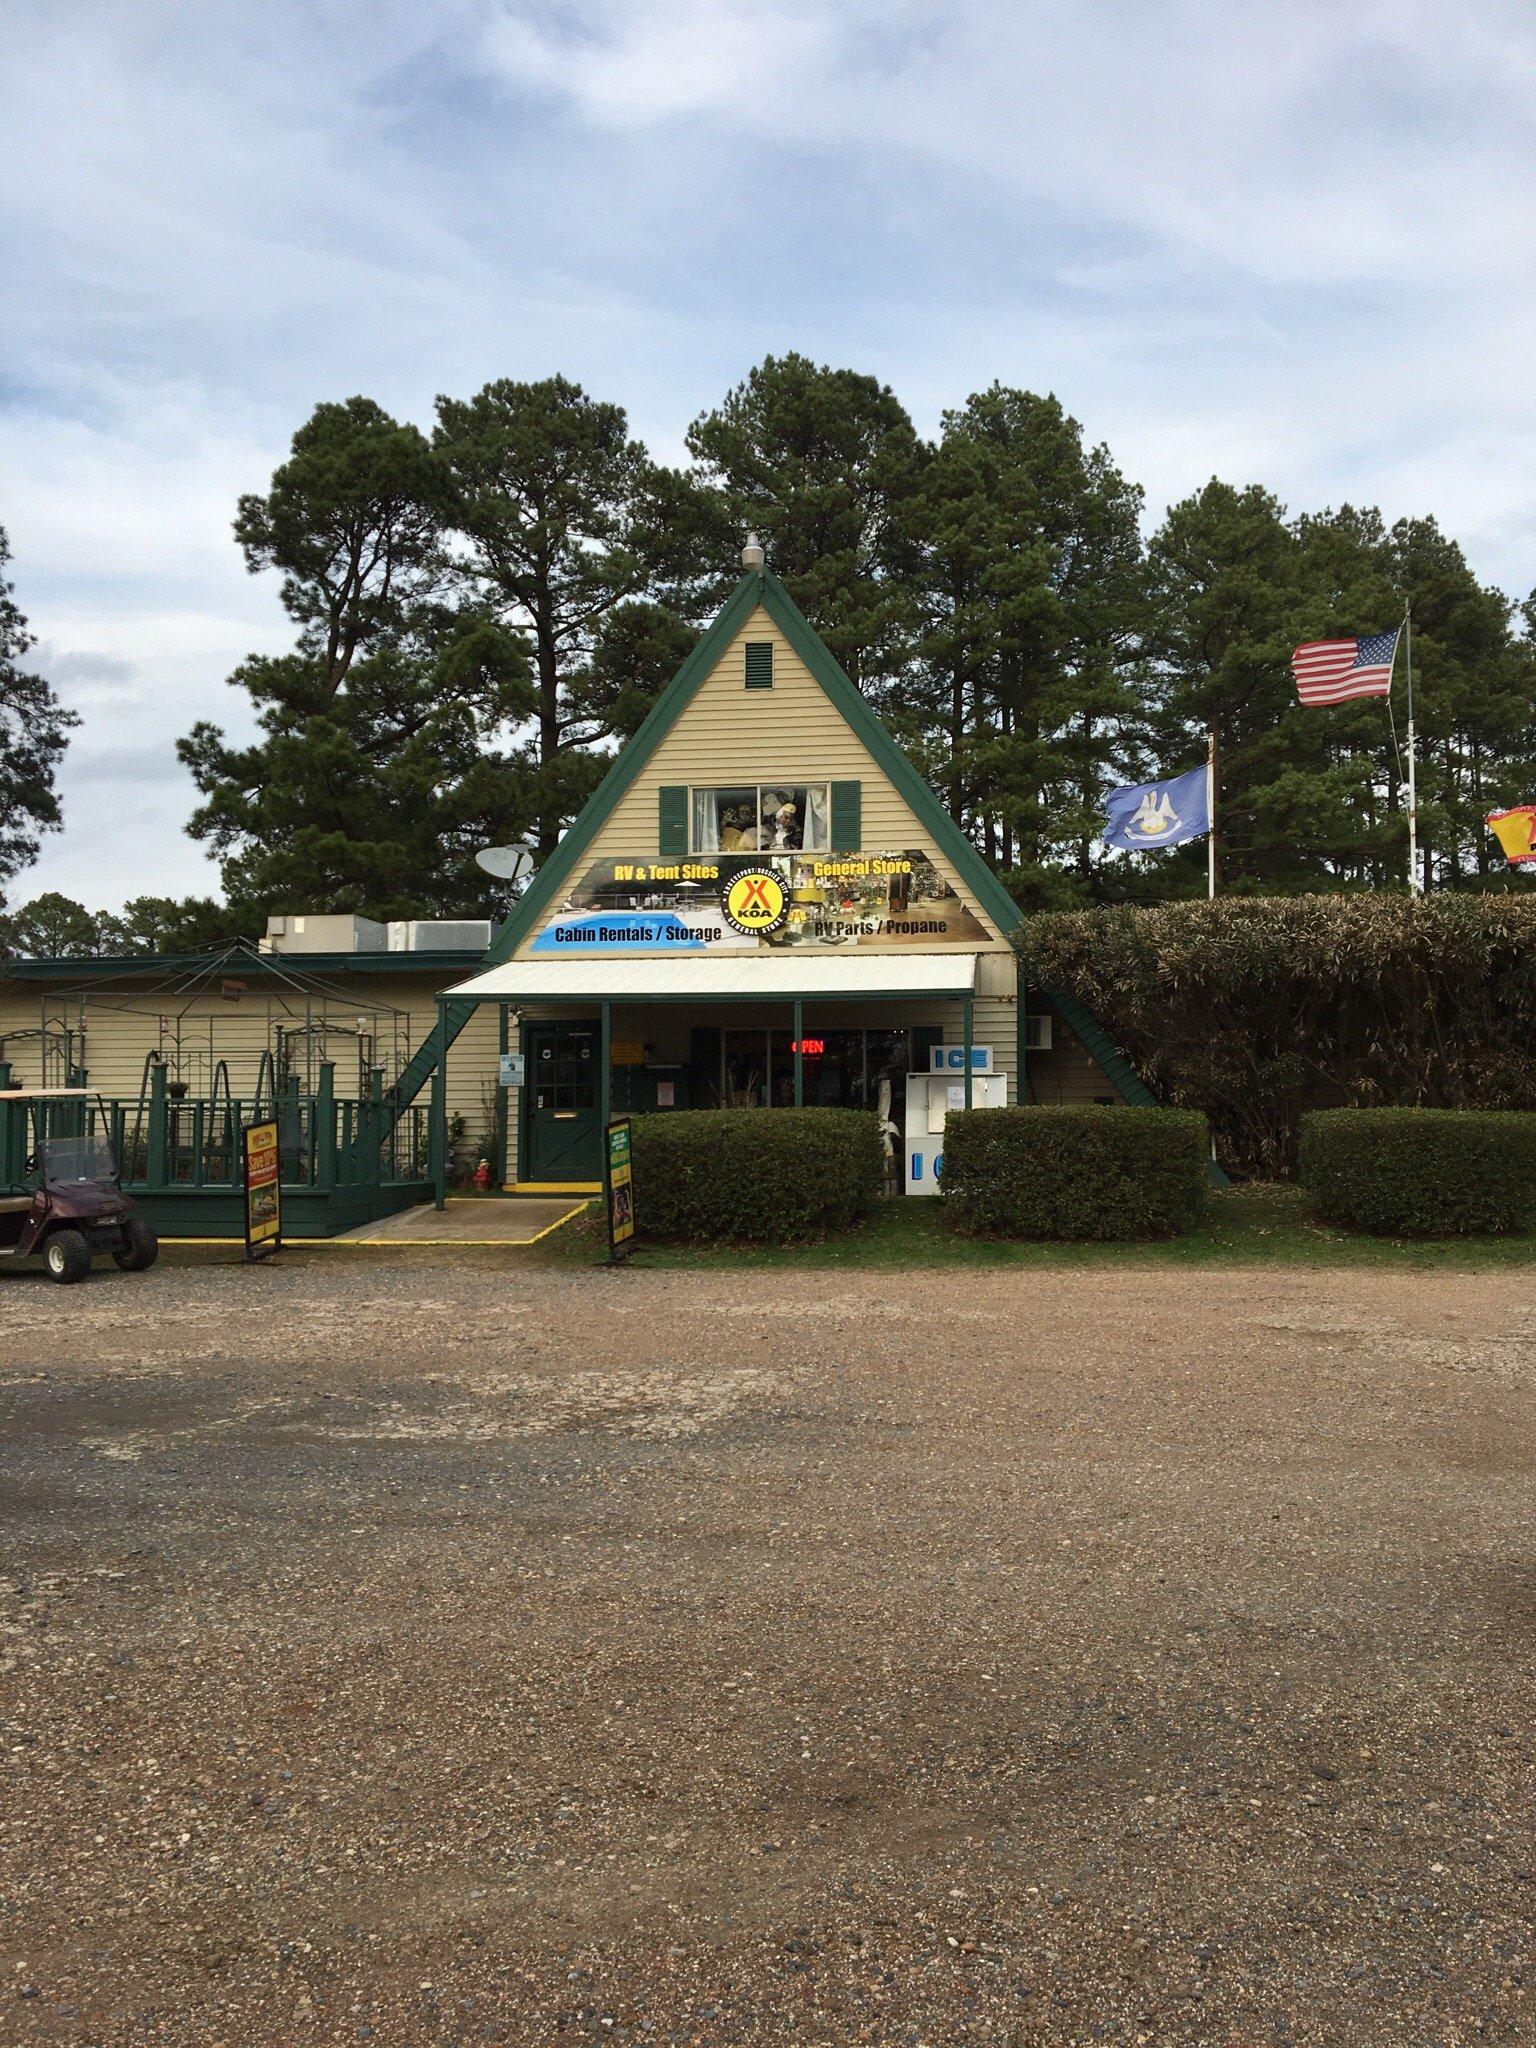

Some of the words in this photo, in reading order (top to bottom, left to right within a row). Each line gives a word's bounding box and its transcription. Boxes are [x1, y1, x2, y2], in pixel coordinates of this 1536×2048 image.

[614, 865, 634, 881] RV
[635, 867, 647, 880] &
[649, 864, 680, 880] Tent
[682, 864, 719, 879] Sites
[813, 861, 870, 877] General
[872, 859, 911, 875] Store
[737, 909, 773, 918] KOA
[555, 927, 596, 942] Cabin
[599, 926, 653, 942] Rentals
[655, 925, 664, 941] /
[666, 925, 722, 941] Storage
[727, 916, 759, 935] GENERAL
[761, 917, 784, 934] STORE
[814, 921, 834, 937] RV
[836, 921, 874, 936] Parts
[876, 920, 884, 935] /
[886, 919, 947, 935] Propane
[935, 1049, 988, 1068] ICE
